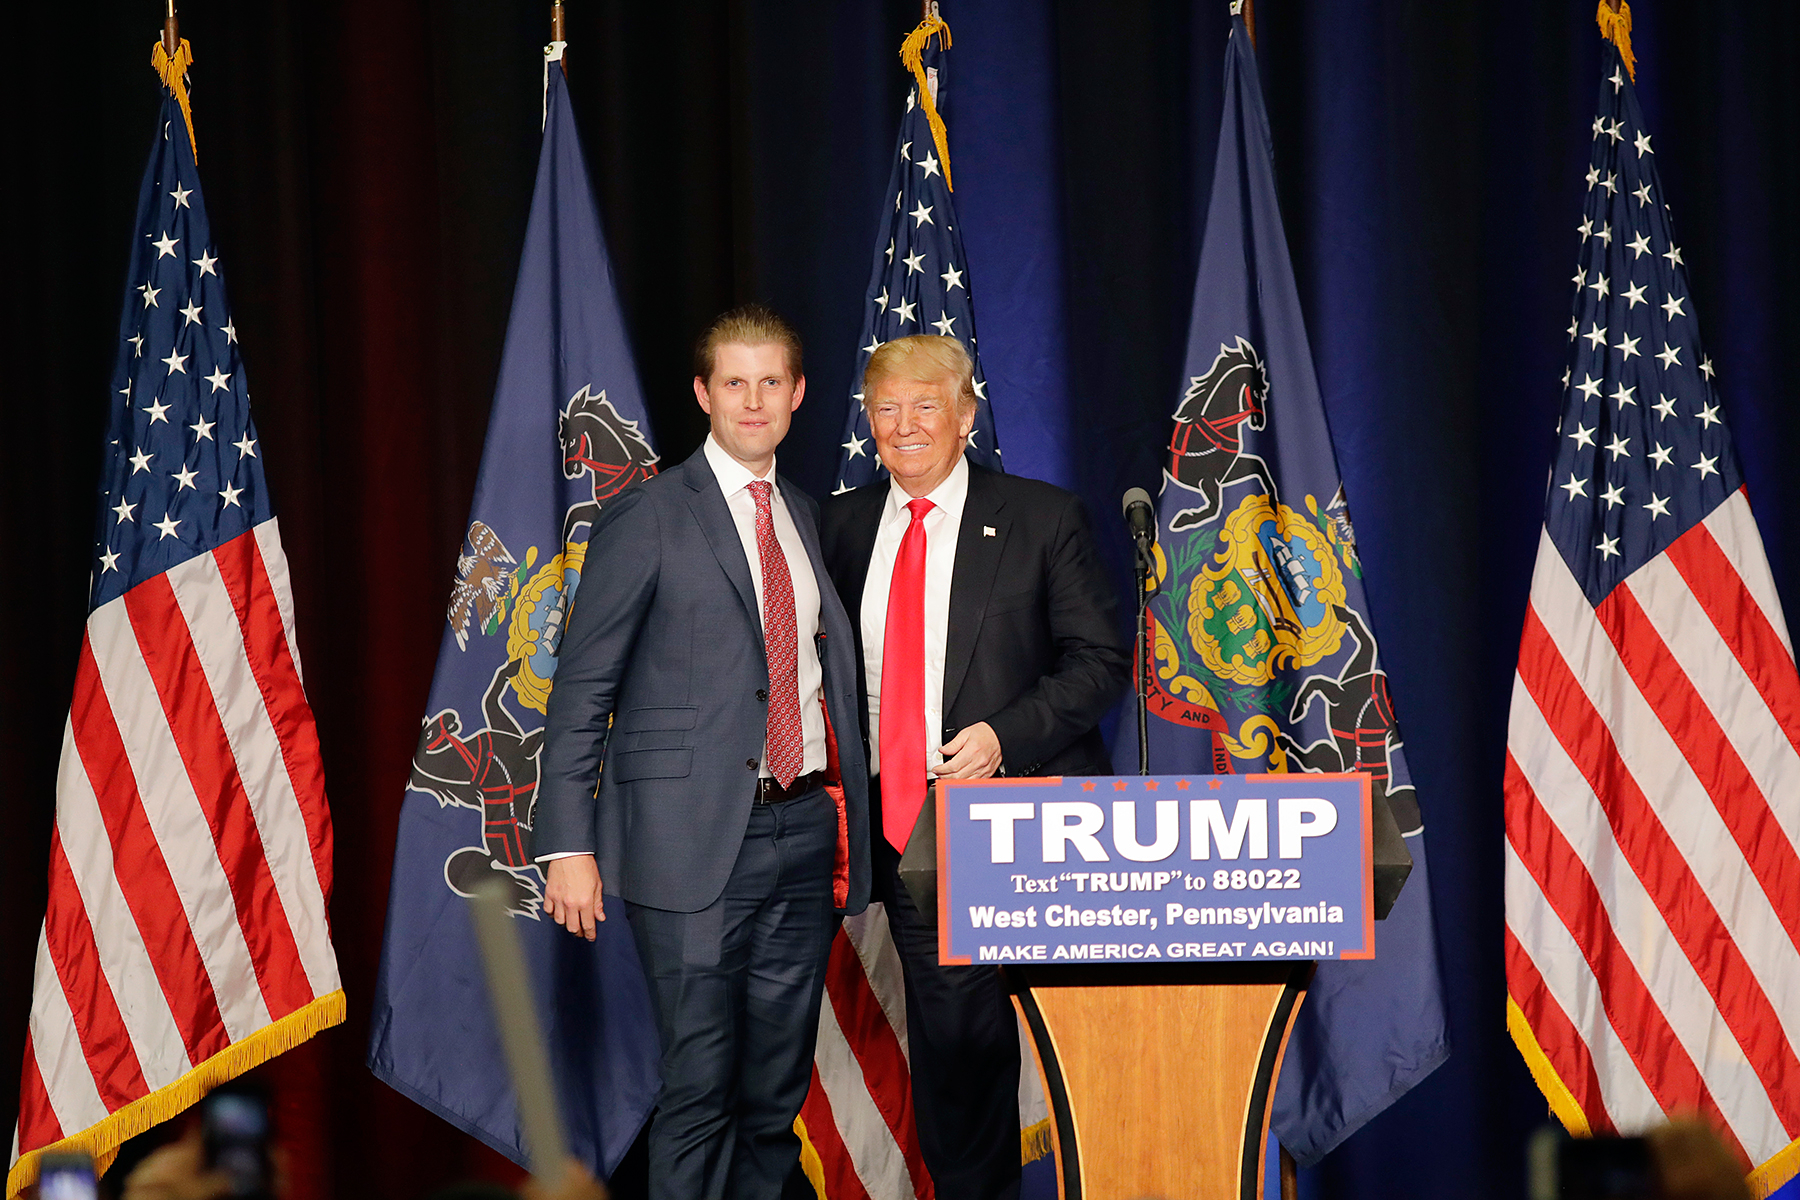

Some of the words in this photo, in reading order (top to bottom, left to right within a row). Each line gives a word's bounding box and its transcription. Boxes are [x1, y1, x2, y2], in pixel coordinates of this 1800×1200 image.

[1180, 709, 1210, 724] AND
[969, 798, 1338, 864] TRUMP
[1010, 874, 1059, 893] Text
[1184, 873, 1206, 891] to
[1212, 868, 1301, 890] 88022
[968, 905, 1037, 928] West
[1044, 903, 1158, 931] Chester,
[1166, 901, 1344, 930] Pennsylvania
[979, 945, 1048, 961] MAKE
[1052, 943, 1162, 960] AMERICA
[1166, 942, 1247, 958] GREAT
[1251, 941, 1335, 957] AGAIN!
